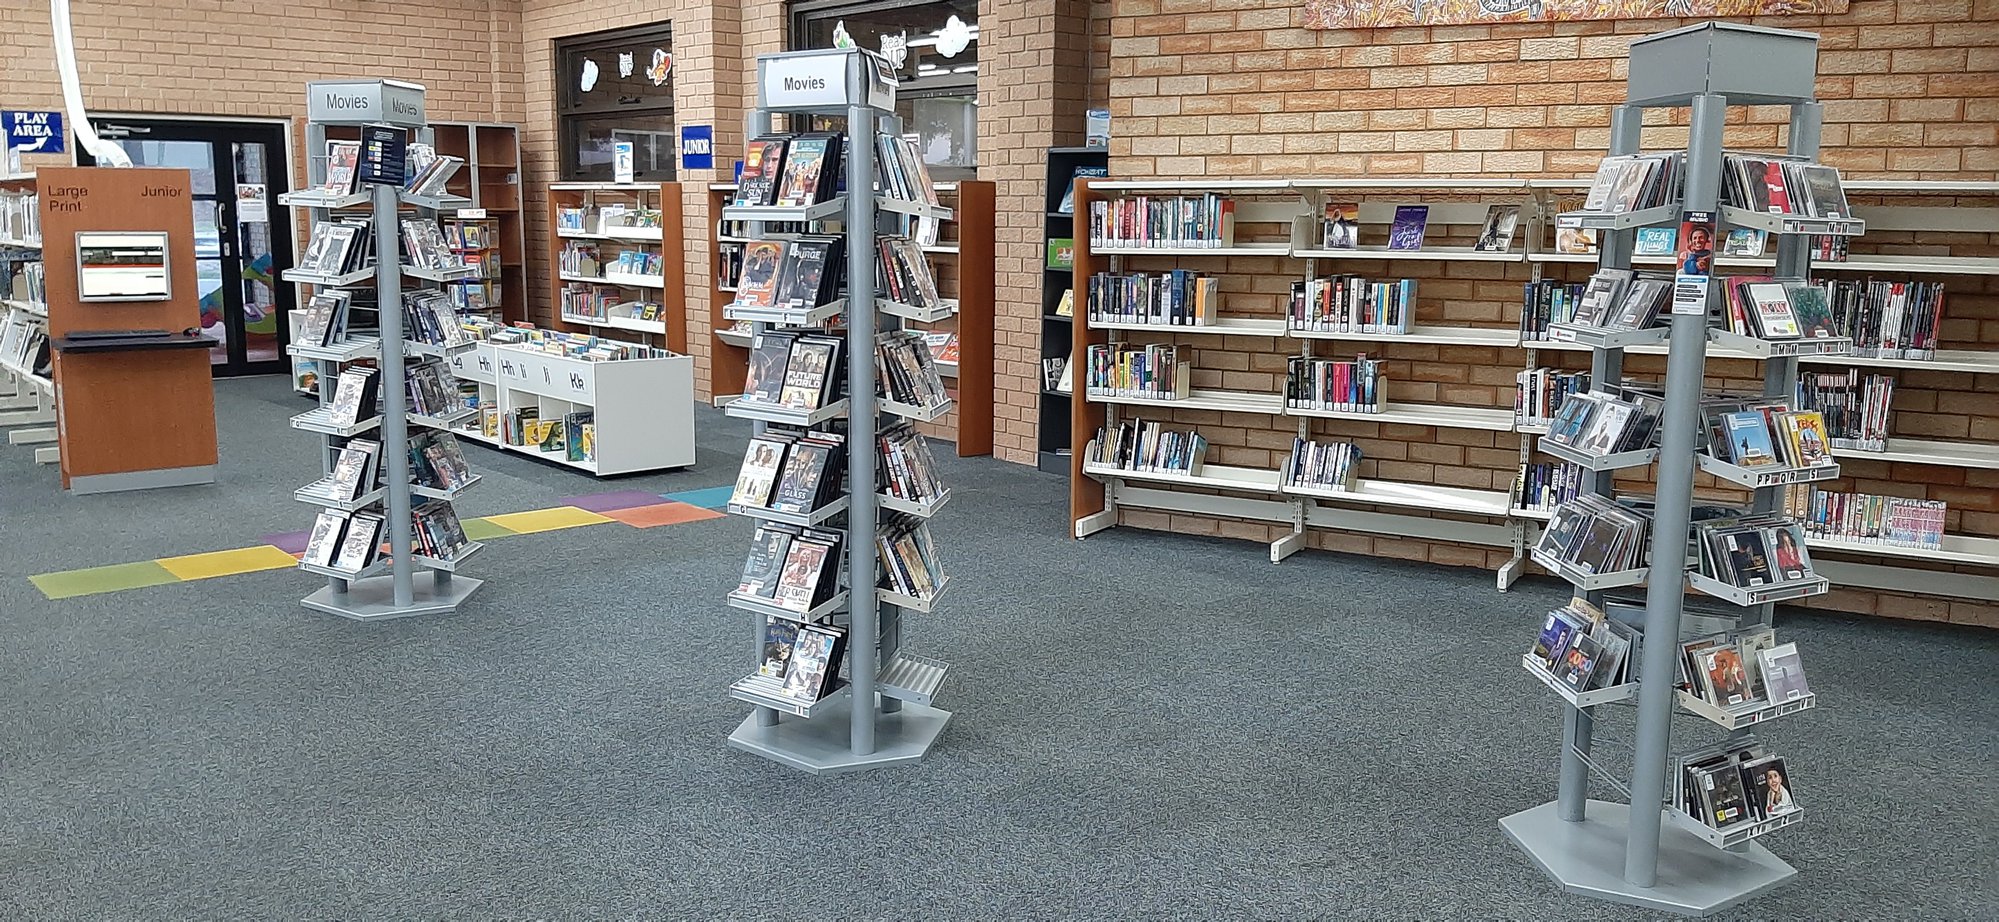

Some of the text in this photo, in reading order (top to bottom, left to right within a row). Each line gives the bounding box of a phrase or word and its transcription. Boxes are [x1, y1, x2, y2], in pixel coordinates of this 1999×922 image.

[882, 31, 906, 49] Read
[784, 76, 825, 91] Movies
[326, 94, 368, 109] Movies
[392, 98, 418, 115] Movies
[14, 113, 49, 124] PLAY
[13, 125, 53, 136] AREA
[683, 139, 710, 155] JUNIOR
[48, 185, 88, 199] Large
[140, 184, 182, 197] Junior
[50, 200, 82, 212] Print
[1646, 231, 1670, 241] REAL
[1637, 240, 1669, 252] THINGS
[794, 251, 821, 259] PURGE
[478, 355, 492, 372] Hh
[501, 359, 515, 376] Hh
[786, 370, 822, 381] FUTURE
[786, 378, 820, 388] WORLD
[1757, 474, 1762, 485] P
[1765, 474, 1770, 484] P
[1790, 472, 1795, 482] R
[1811, 470, 1816, 479] S
[784, 490, 806, 499] GLASS
[1750, 593, 1755, 603] S
[800, 613, 806, 621] H
[1568, 649, 1592, 671] COCO
